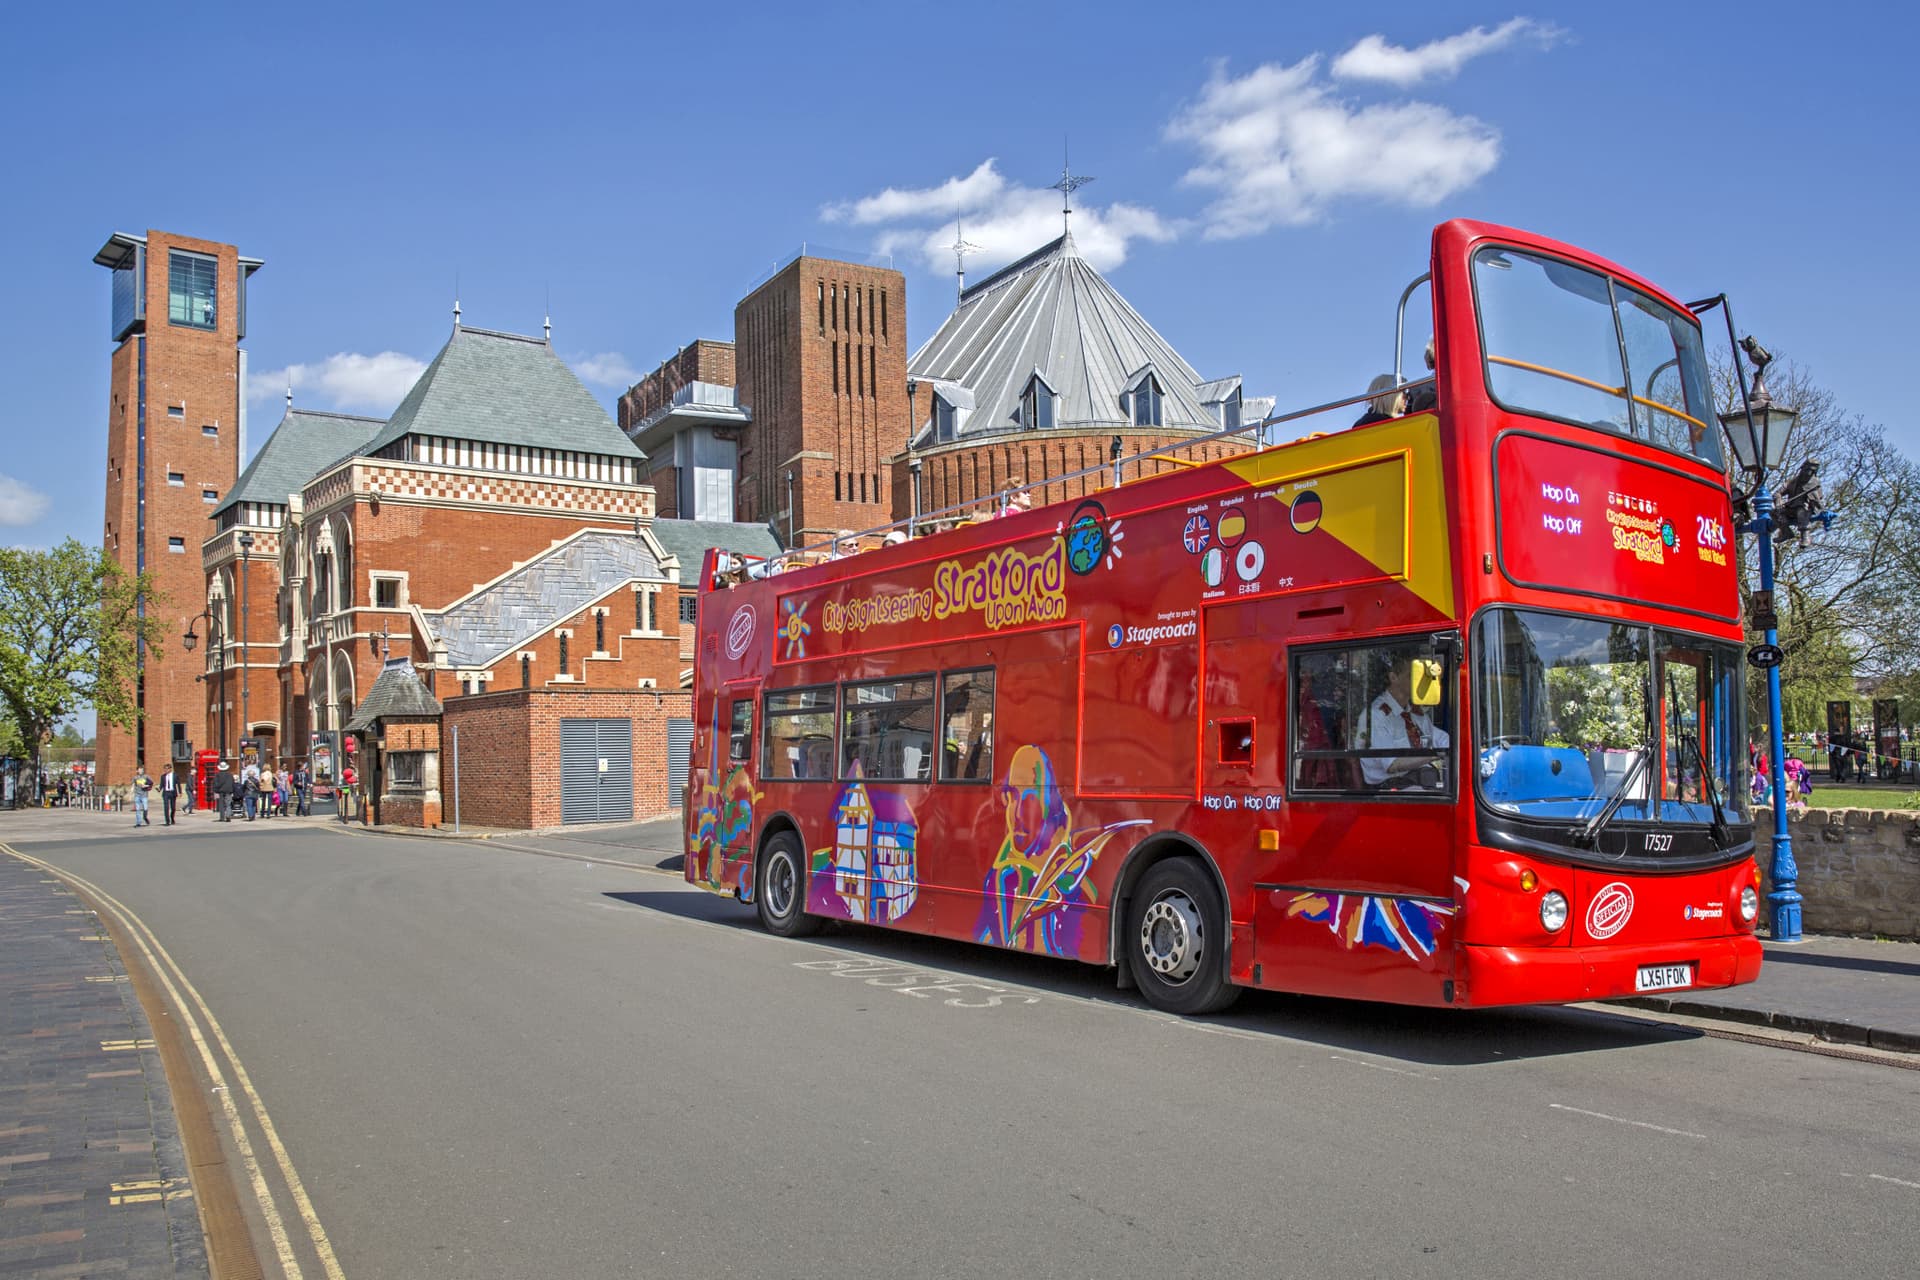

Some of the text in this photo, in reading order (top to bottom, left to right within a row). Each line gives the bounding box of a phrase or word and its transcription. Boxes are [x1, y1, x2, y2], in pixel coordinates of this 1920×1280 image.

[1220, 496, 1244, 507] Español
[1542, 483, 1580, 504] Hop On
[1187, 504, 1209, 514] English
[1543, 515, 1582, 534] Hop Off
[1697, 515, 1711, 546] 24
[1612, 526, 1663, 554] Stratford
[934, 535, 1066, 619] Stratford
[822, 588, 934, 634] CitySightseeing
[985, 600, 1024, 630] Upon
[1158, 611, 1175, 620] brought
[1181, 610, 1190, 619] you
[1190, 608, 1197, 618] by
[1126, 620, 1197, 645] Stagecoach
[1203, 795, 1281, 811] Hop On Hop Off
[1645, 834, 1673, 851] 17527
[1595, 896, 1626, 925] OFFICIAL
[1693, 907, 1723, 920] Stagecoach
[793, 958, 1041, 1008] BUSES
[1641, 968, 1687, 987] LX51 FOK
